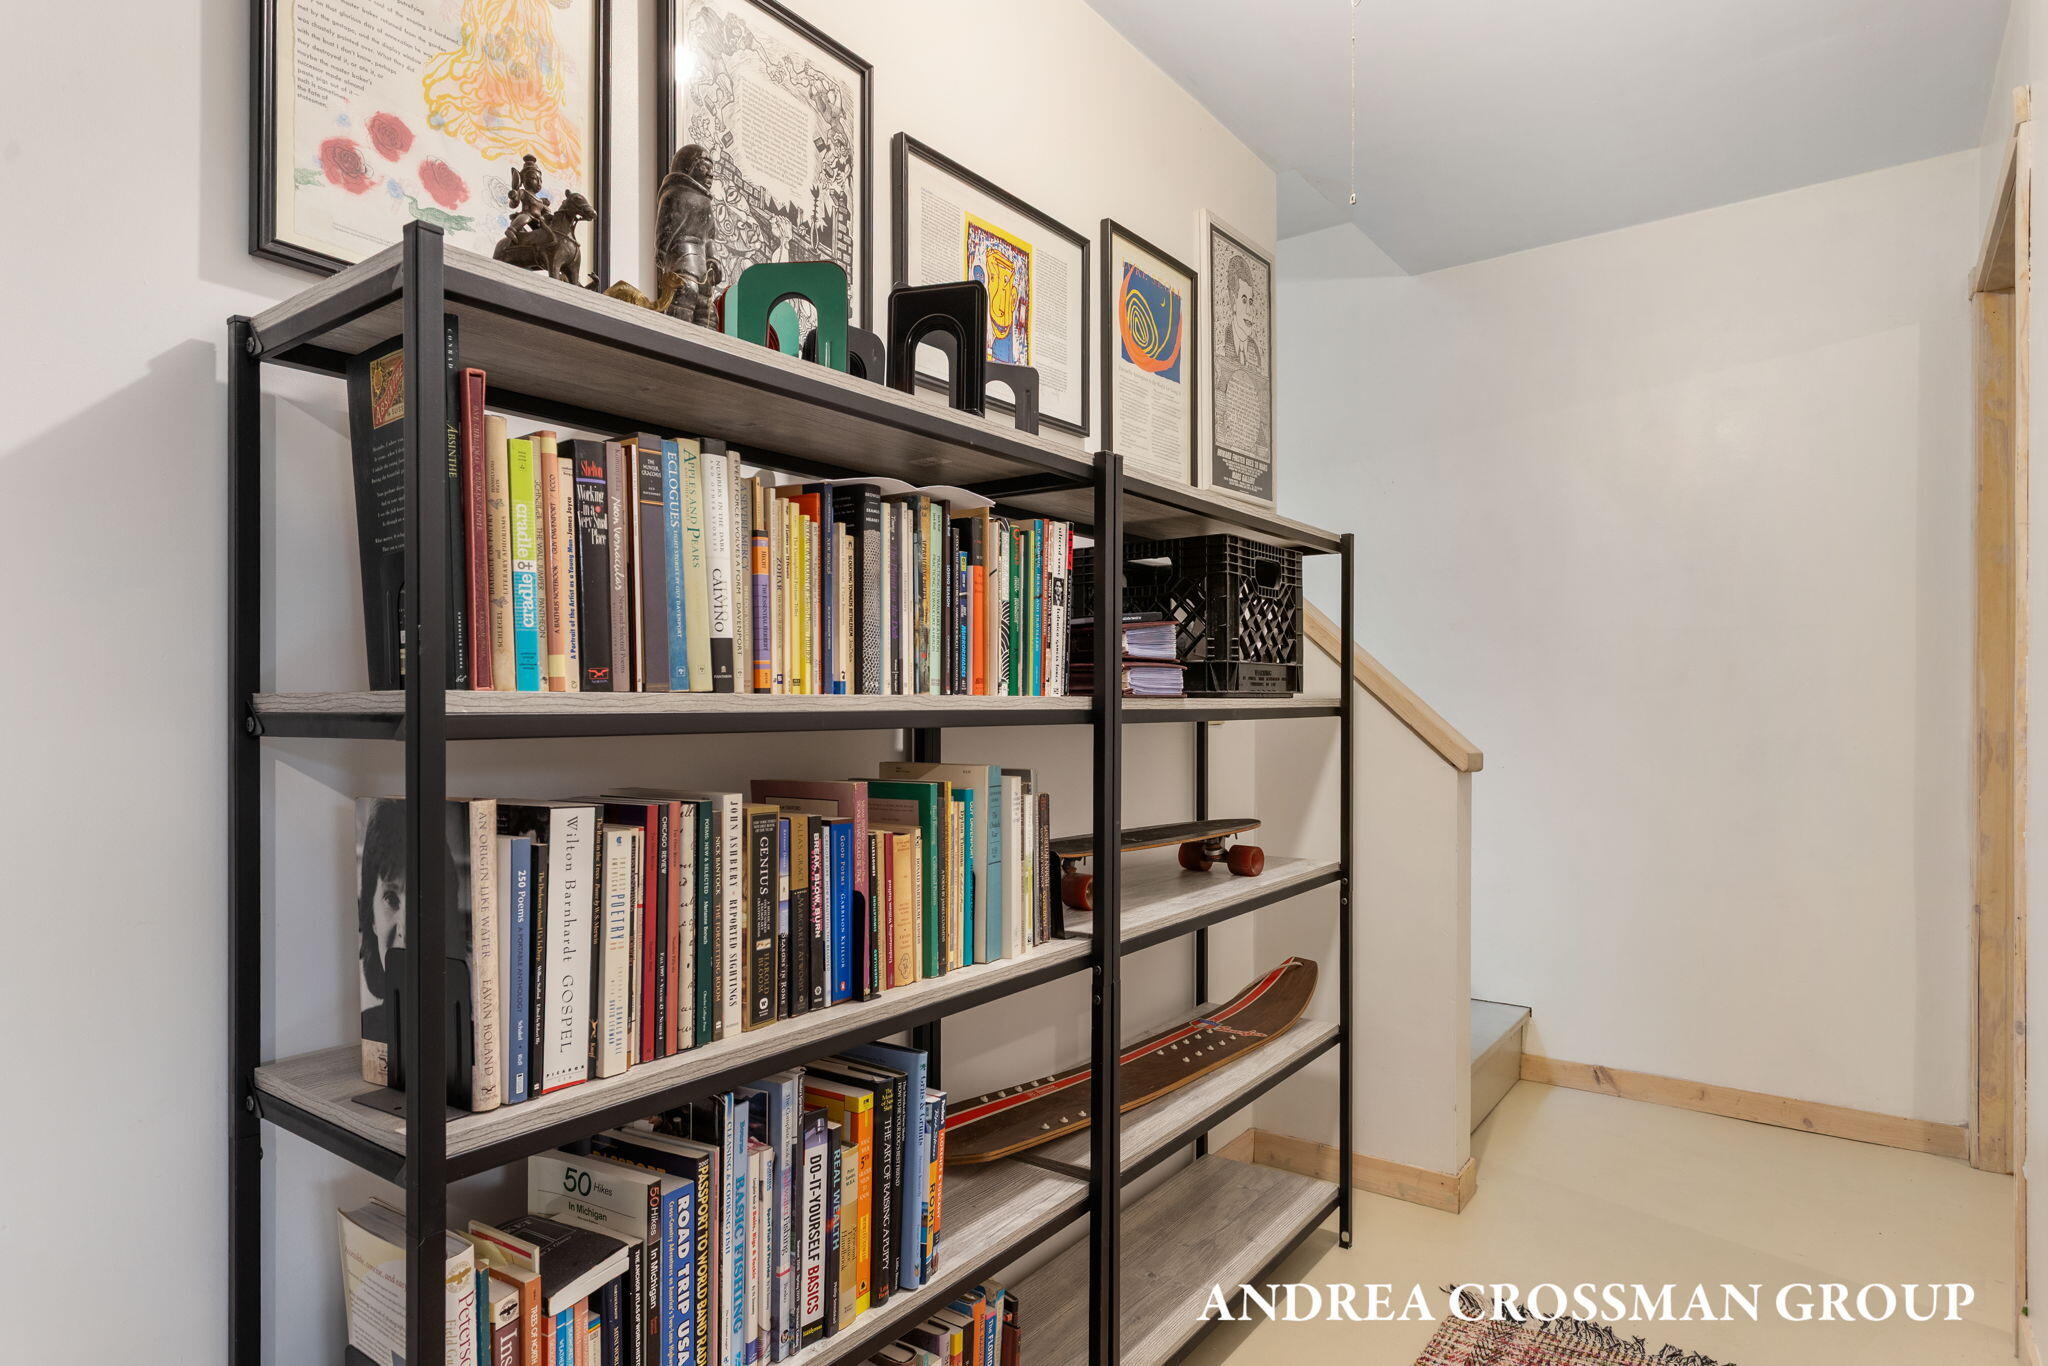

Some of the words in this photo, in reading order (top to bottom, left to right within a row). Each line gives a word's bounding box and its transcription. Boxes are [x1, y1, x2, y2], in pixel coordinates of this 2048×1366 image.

[298, 38, 309, 47] they
[313, 44, 341, 60] destroyed
[374, 62, 396, 75] perhaps
[377, 51, 391, 61] What
[344, 80, 364, 91] almond
[446, 423, 458, 479] ABSINTHE
[667, 451, 680, 528] ECLOGUES
[683, 448, 697, 497] APPLES
[715, 460, 723, 497] NUMBERS
[577, 484, 604, 503] Working
[612, 497, 622, 525] Neon
[689, 499, 699, 525] AND
[516, 503, 533, 558] cradle
[741, 496, 749, 532] SEVERE
[613, 528, 624, 591] Vernacular
[687, 527, 701, 569] PEARS
[741, 534, 750, 571] MERCY
[518, 573, 534, 627] cradle
[712, 568, 724, 633] CALVINO
[478, 812, 488, 830] AN
[661, 816, 669, 847] CHICAGO
[730, 801, 739, 831] JOHN
[478, 834, 489, 882] ORIGIN
[565, 816, 579, 872] Wilton
[660, 850, 668, 874] REVIEW
[730, 836, 739, 887] ASHBERY
[813, 833, 821, 870] BREAK,
[518, 870, 527, 888] 250
[759, 836, 770, 896] GENIUS
[839, 861, 847, 886] POEMS
[480, 887, 490, 913] LIKE
[518, 891, 527, 923] Poems
[611, 893, 625, 940] POETRY
[839, 893, 847, 933] GARRISON
[480, 916, 491, 960] WATER
[562, 880, 578, 962] Barnhardt
[729, 900, 738, 949] REPORTED
[839, 935, 847, 969] KEILLOR
[729, 953, 738, 1007] SIGHTINGS
[779, 981, 787, 1005] ROME
[483, 980, 493, 1021] EAVAN
[560, 975, 575, 1053] GOSPEL
[483, 1024, 494, 1076] BOLAND
[883, 1117, 892, 1143] THE
[832, 1149, 841, 1188] REAL
[883, 1143, 892, 1163] ART
[563, 1166, 592, 1197] 50
[593, 1181, 613, 1197] Hikes
[783, 1168, 791, 1216] Saltwater
[883, 1163, 891, 1183] OF
[568, 1201, 576, 1211] In
[577, 1203, 608, 1222] Michigan
[649, 1185, 660, 1206] 50
[697, 1165, 710, 1231] PASSPORT
[725, 1183, 733, 1229] COOKING
[735, 1174, 746, 1240] BASIC
[808, 1154, 822, 1262] DO-IT-YOURSELF
[882, 1183, 891, 1227] RAISING
[928, 1183, 936, 1235] ROME
[650, 1207, 660, 1236] Hikes
[677, 1193, 691, 1259] ROAD
[781, 1217, 791, 1256] Fishing
[831, 1189, 841, 1251] WEALTH
[651, 1248, 659, 1260] In
[697, 1233, 709, 1249] TO
[881, 1236, 890, 1271] PUPPY
[648, 1261, 660, 1309] Michigan
[677, 1263, 691, 1315] TRIP
[697, 1250, 708, 1300] WORLD
[733, 1242, 745, 1335] FISHING
[806, 1265, 820, 1315] BASICS
[446, 1320, 457, 1345] Field
[530, 1305, 539, 1327] TREES
[530, 1328, 538, 1338] OF
[696, 1299, 708, 1336] BAND
[530, 1340, 538, 1365] NORTH
